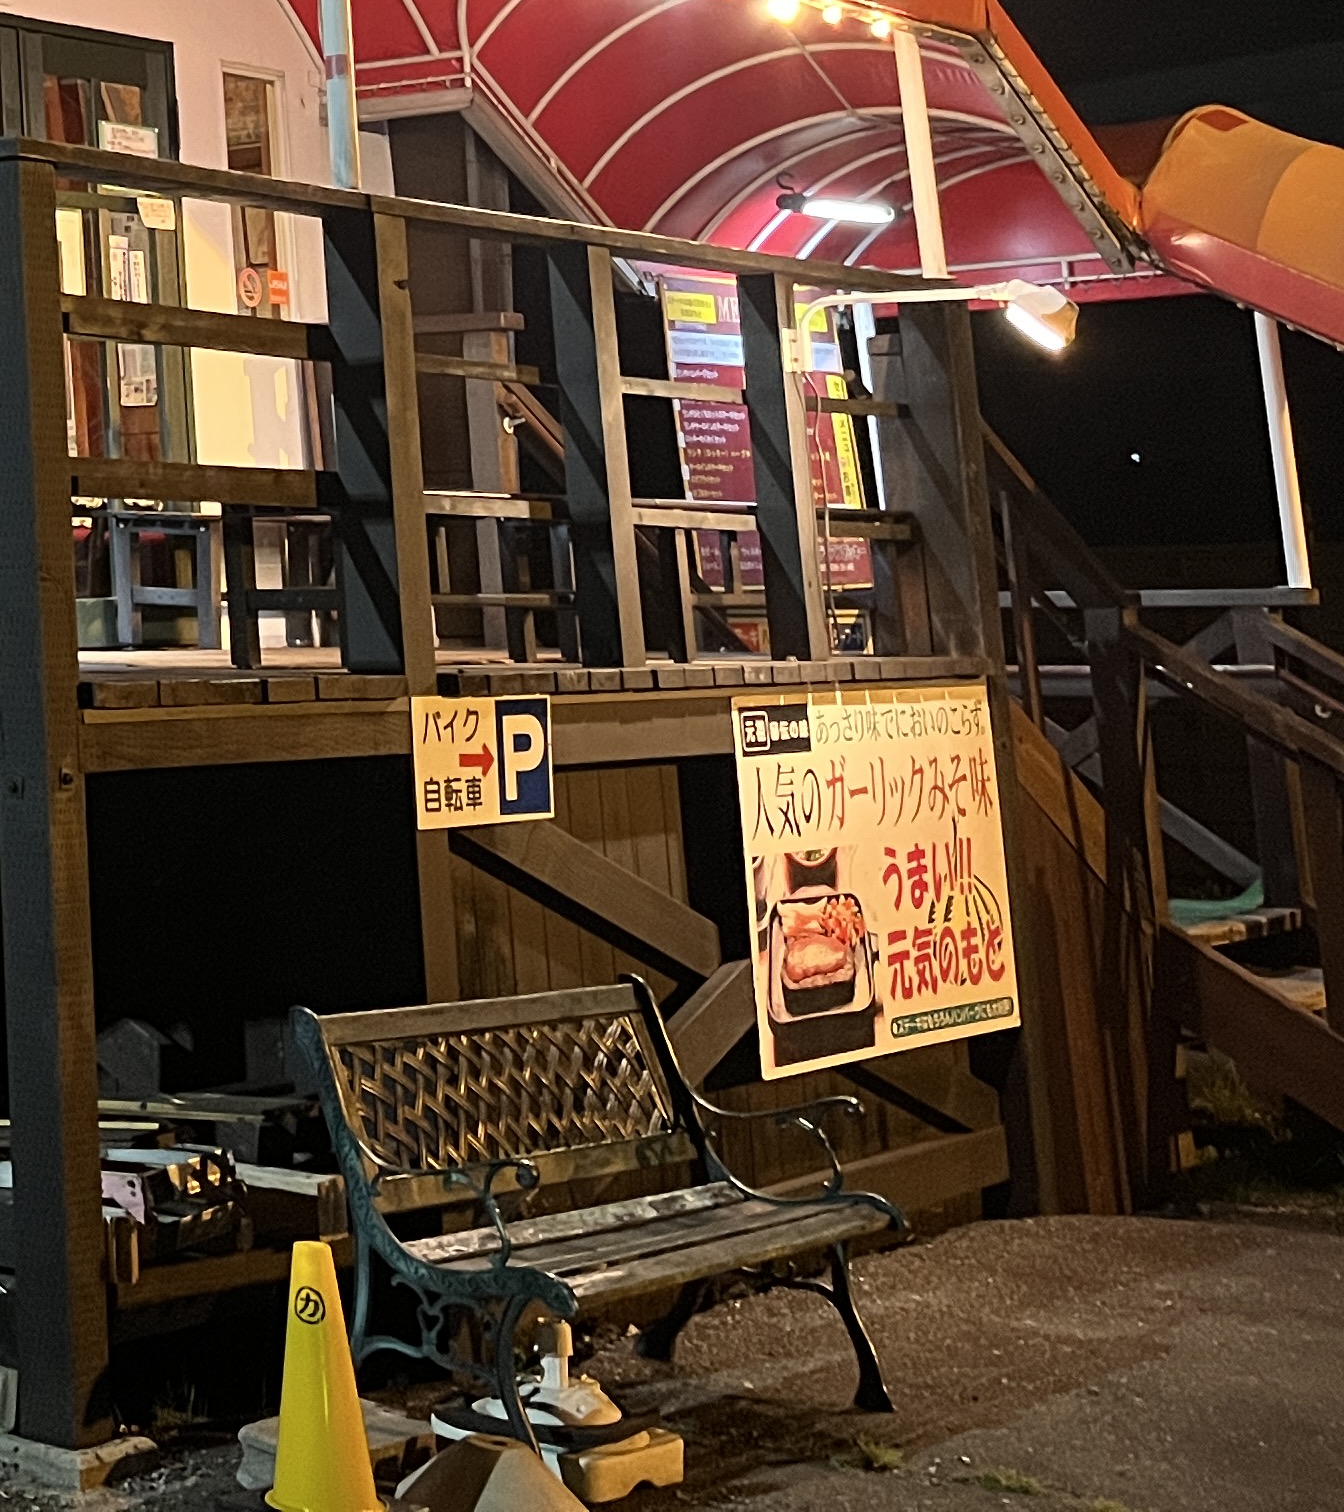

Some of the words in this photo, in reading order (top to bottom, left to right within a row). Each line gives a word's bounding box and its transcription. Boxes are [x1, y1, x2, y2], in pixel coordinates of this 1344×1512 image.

[423, 708, 479, 744] バイク
[502, 714, 545, 801] P
[424, 776, 482, 813] 自転車
[752, 747, 994, 840] 人気のガーリックみそ味
[887, 920, 1005, 1001] 元気のもと
